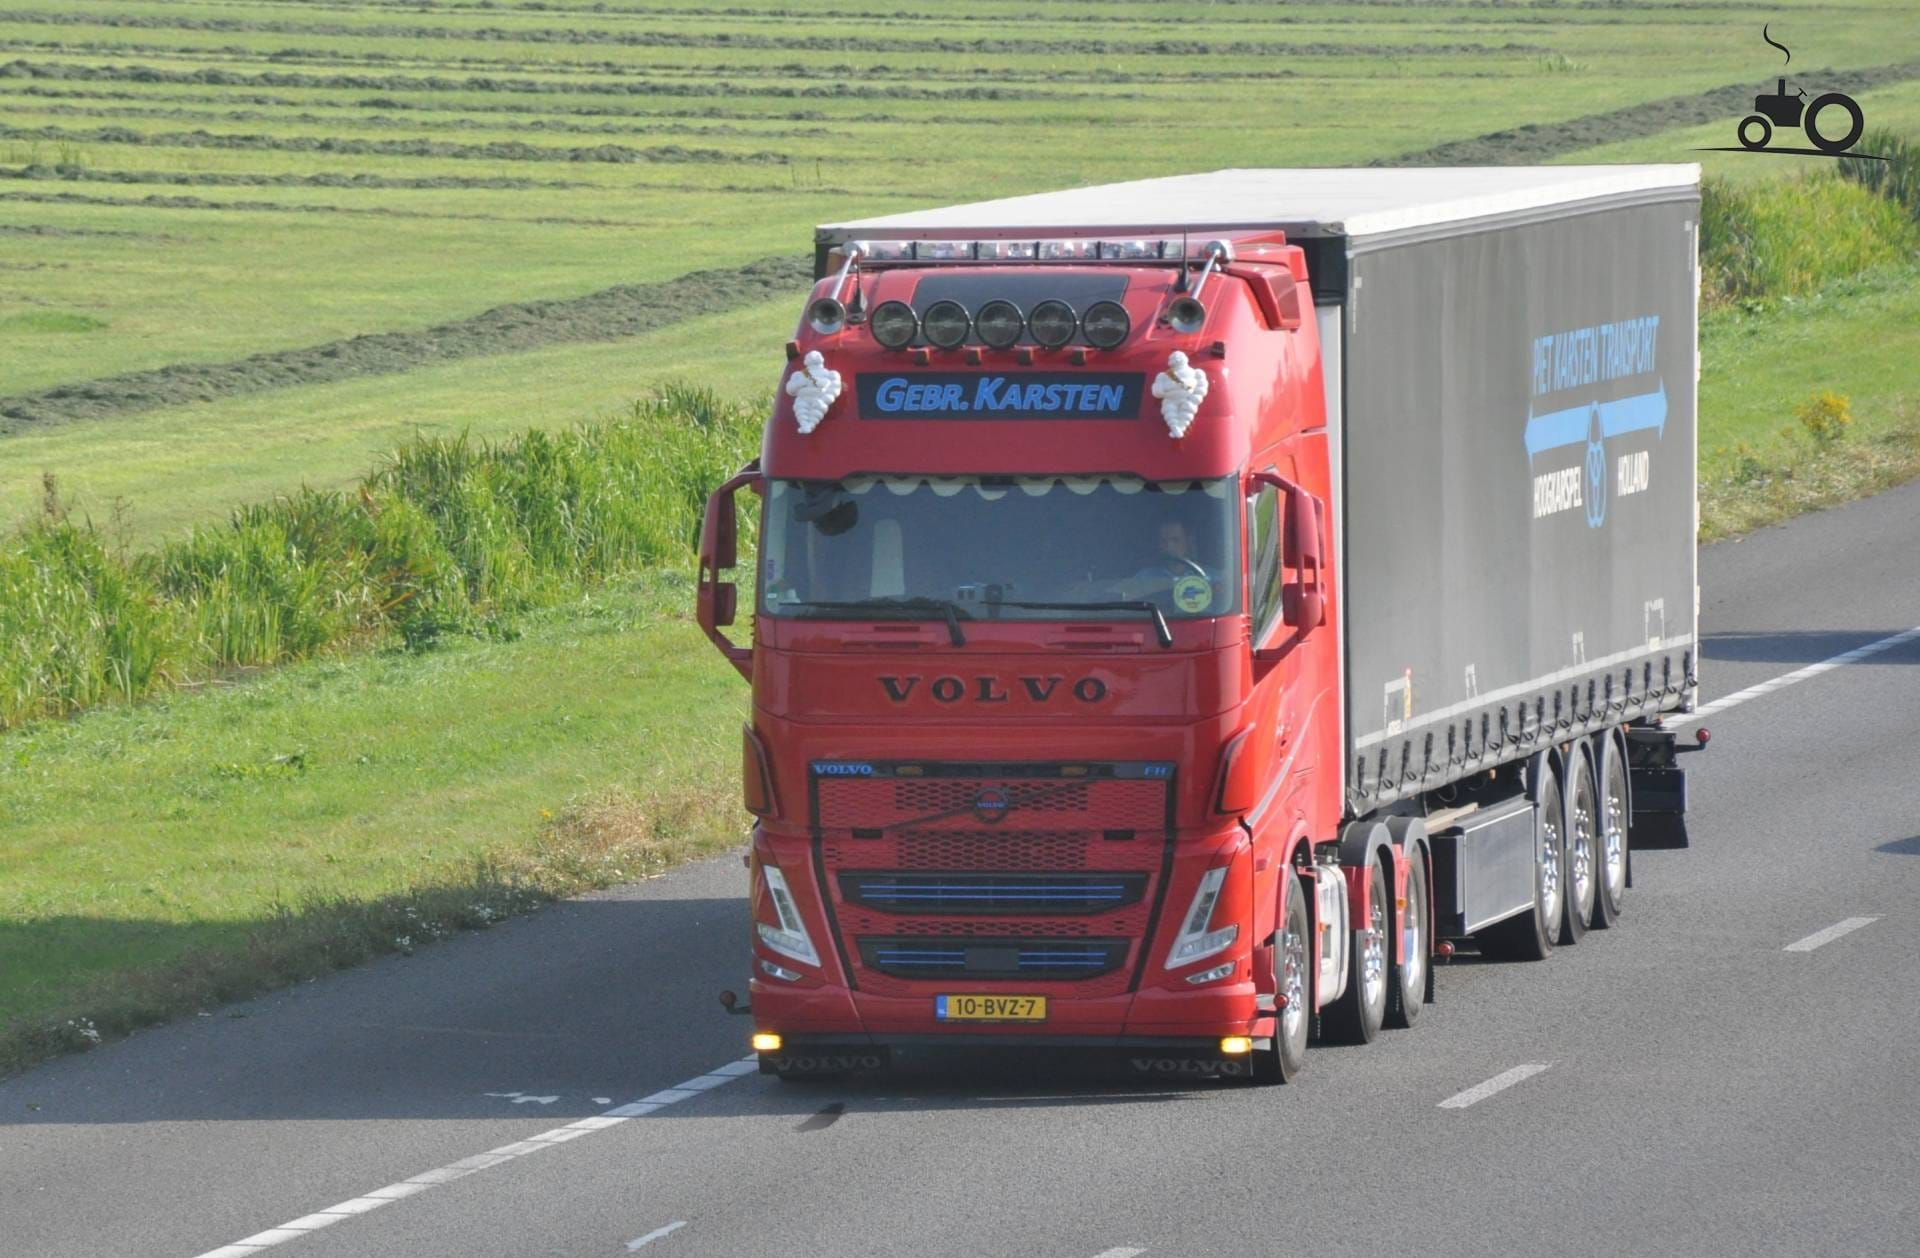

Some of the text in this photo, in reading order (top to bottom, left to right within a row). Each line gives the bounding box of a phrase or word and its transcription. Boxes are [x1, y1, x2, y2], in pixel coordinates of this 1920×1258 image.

[1554, 327, 1599, 391] KARSTEN
[1601, 316, 1659, 380] TRANSPORT
[876, 378, 1124, 411] GEBR. KARSTEN
[1618, 451, 1649, 496] HOLLAND
[880, 676, 1108, 702] VOLVO
[812, 764, 873, 775] VOLVO
[956, 998, 1036, 1016] 10-BVZ-7
[768, 1055, 880, 1072] VOLVO
[1130, 1057, 1242, 1075] VOLVO
